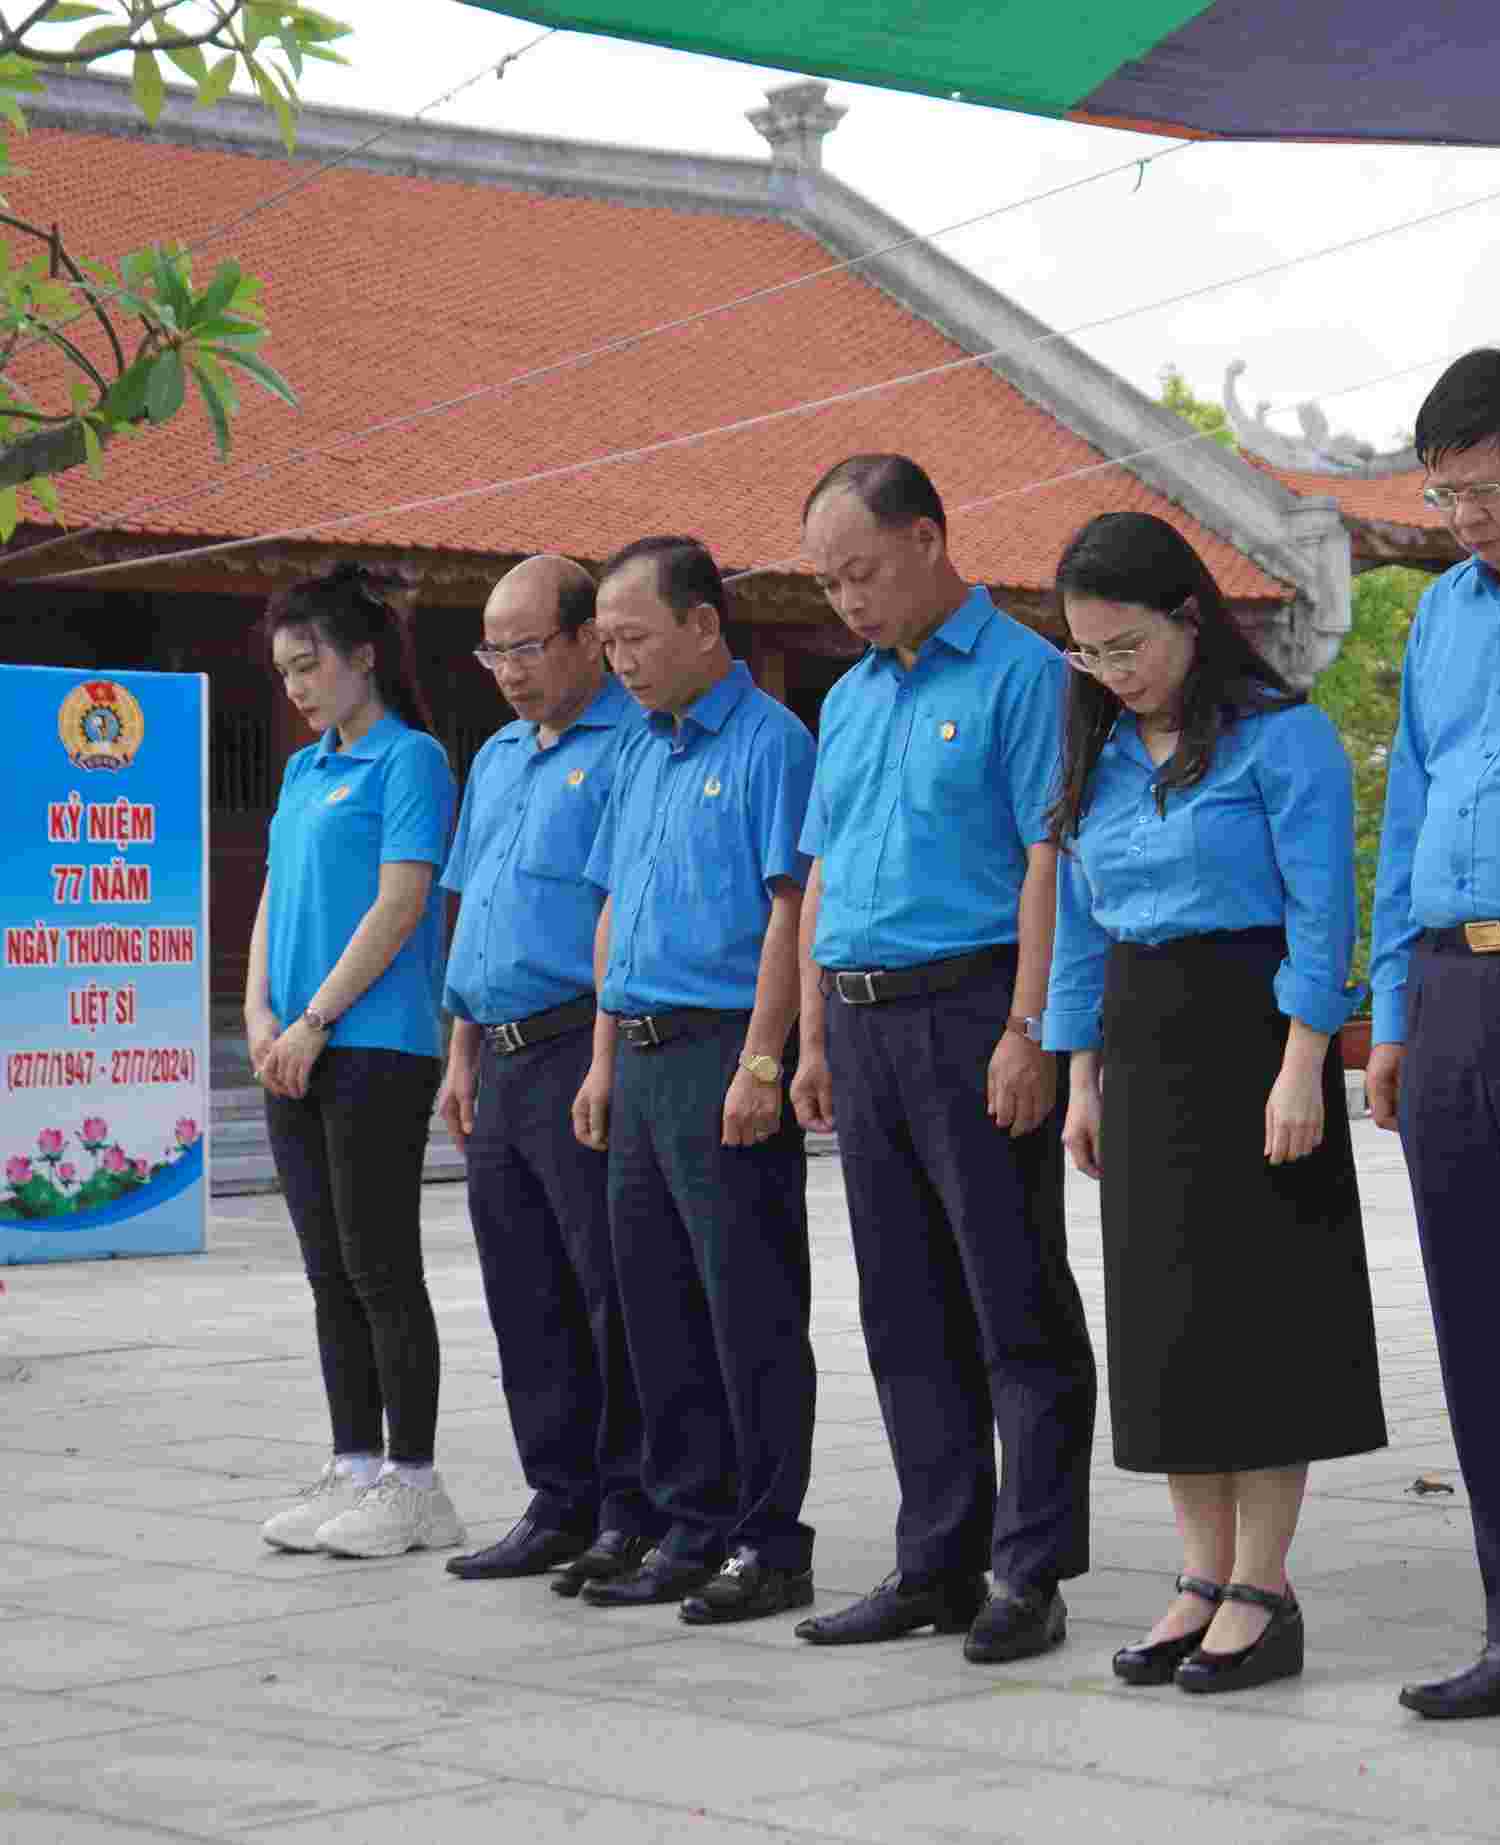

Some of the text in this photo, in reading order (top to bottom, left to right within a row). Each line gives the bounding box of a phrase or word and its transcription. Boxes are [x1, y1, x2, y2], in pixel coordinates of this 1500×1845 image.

[88, 796, 155, 850] NIỆM
[53, 857, 150, 903] 77 NĂM
[7, 921, 59, 966] NGÀY
[69, 984, 109, 1032] LIỆT
